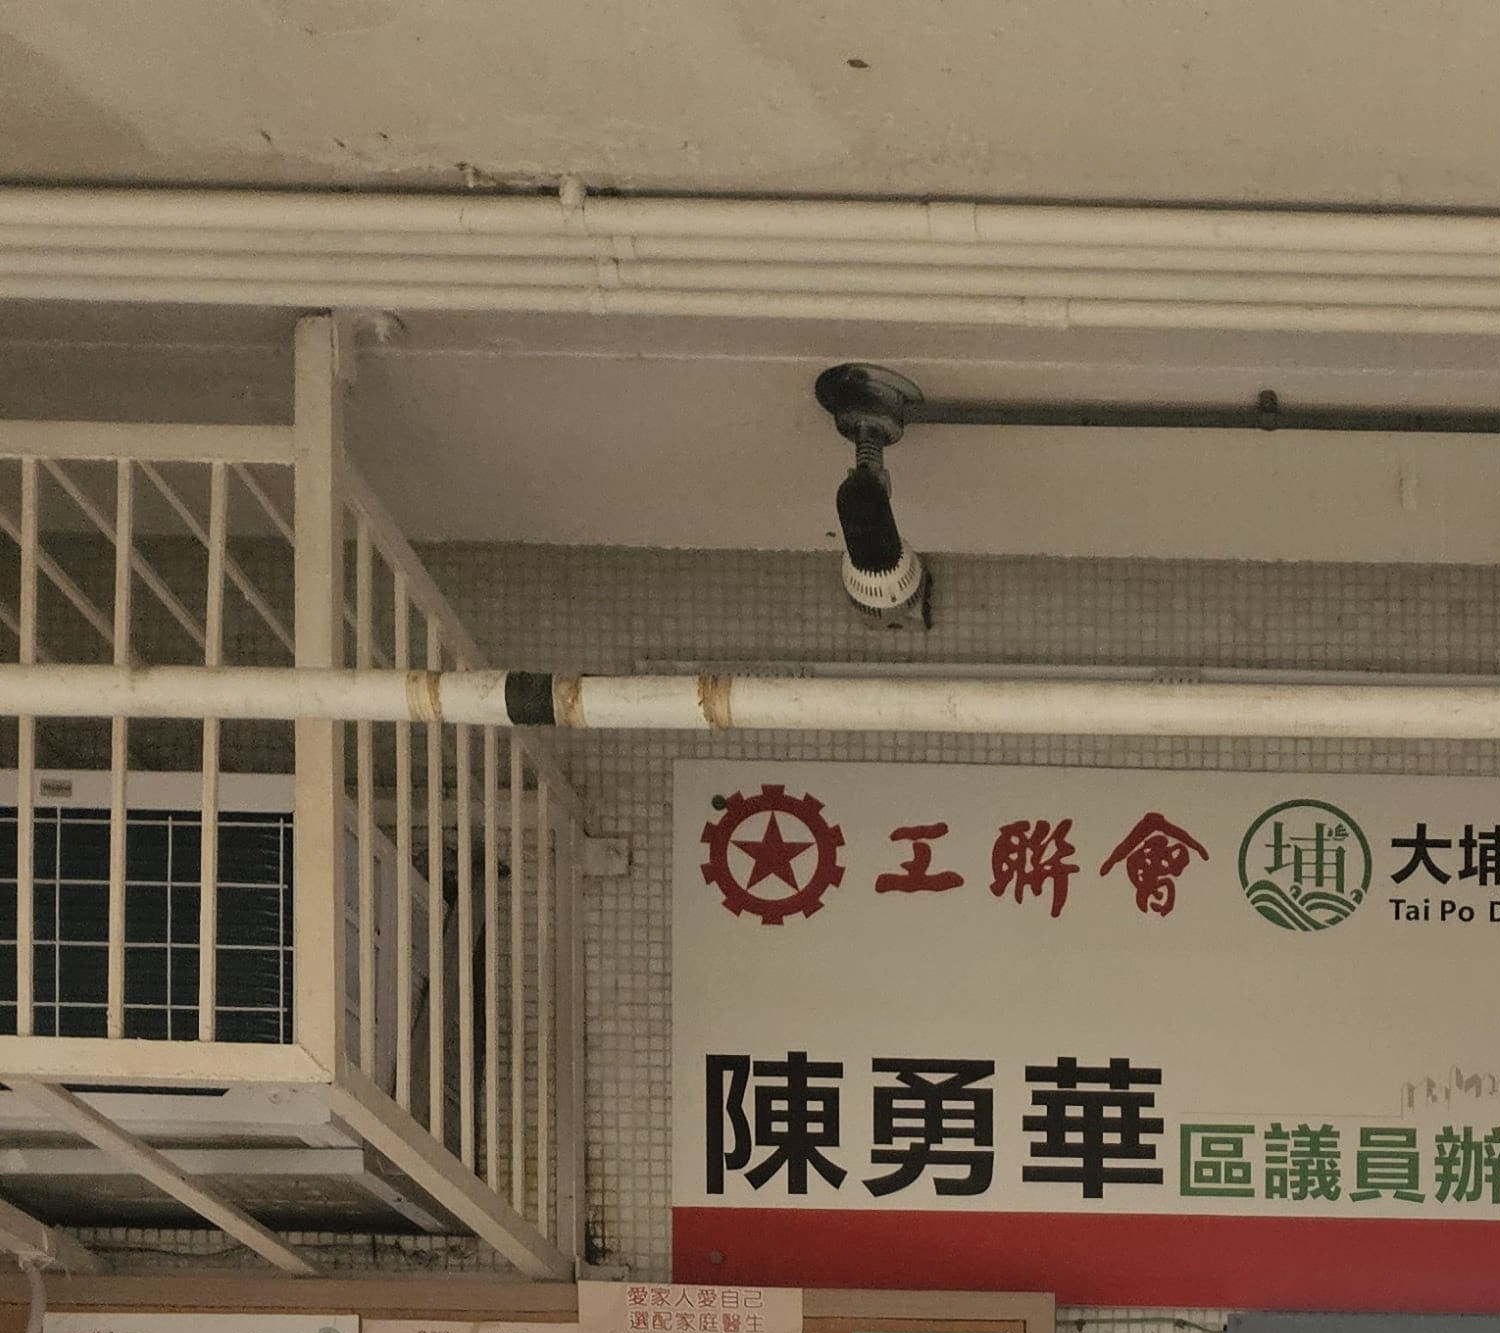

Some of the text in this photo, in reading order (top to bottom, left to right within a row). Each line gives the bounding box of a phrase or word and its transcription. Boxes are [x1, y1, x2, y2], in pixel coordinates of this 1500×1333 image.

[875, 812, 1209, 917] 工聯會
[1389, 898, 1431, 922] Tai
[1440, 899, 1475, 923] Po
[705, 1050, 1165, 1199] 陳勇華
[628, 1286, 764, 1309] 愛家人愛自己
[629, 1310, 765, 1333] 選配家庭醫生
